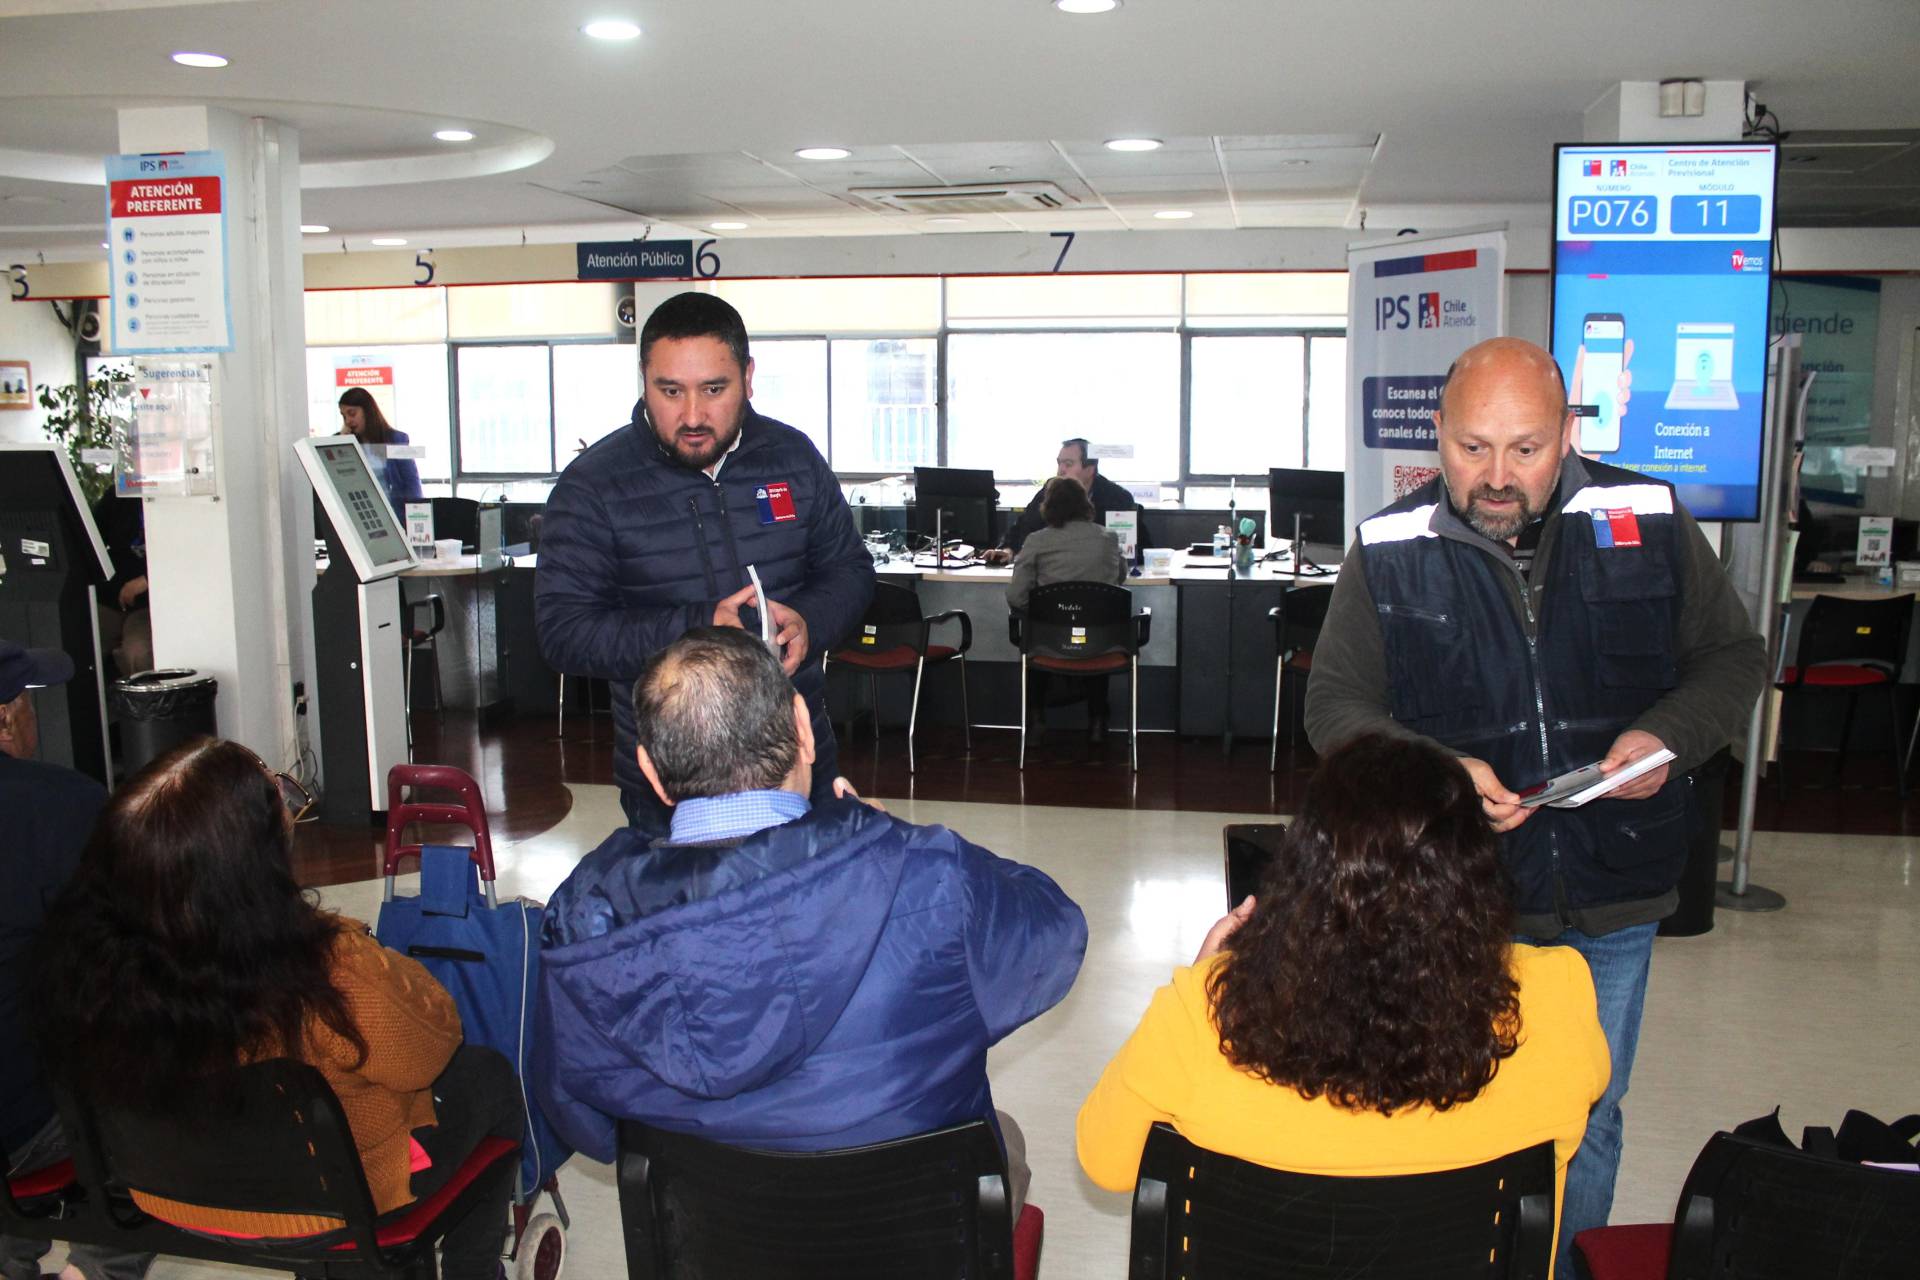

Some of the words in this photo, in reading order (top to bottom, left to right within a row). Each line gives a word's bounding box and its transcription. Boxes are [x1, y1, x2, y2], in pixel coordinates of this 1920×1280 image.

[140, 160, 156, 172] IPS
[1668, 159, 1700, 167] Centro
[1701, 159, 1711, 167] de
[1712, 157, 1751, 167] Atención
[1668, 168, 1715, 177] Previsional
[130, 182, 194, 198] ATENCIÓN
[1699, 182, 1735, 192] MÓDULO
[127, 197, 203, 213] PREFERENTE
[1573, 200, 1650, 227] P076
[1696, 200, 1729, 227] 11
[586, 253, 638, 268] Atención
[641, 250, 684, 266] Público
[695, 239, 720, 278] 6
[1050, 232, 1075, 272] 7
[414, 248, 434, 285] 5
[10, 264, 29, 299] 3
[1375, 294, 1411, 331] IPS
[1443, 299, 1466, 313] Chile
[1443, 314, 1477, 328] Atiende
[1774, 312, 1854, 335] tiende
[143, 368, 201, 381] Sugerencias
[1387, 387, 1427, 400] Escanea
[1428, 386, 1438, 400] el
[1373, 409, 1406, 419] conoce
[1378, 426, 1413, 439] canales
[1414, 426, 1428, 439] de
[1655, 422, 1702, 438] Conexión
[1703, 427, 1710, 437] a
[1654, 445, 1693, 460] Internet
